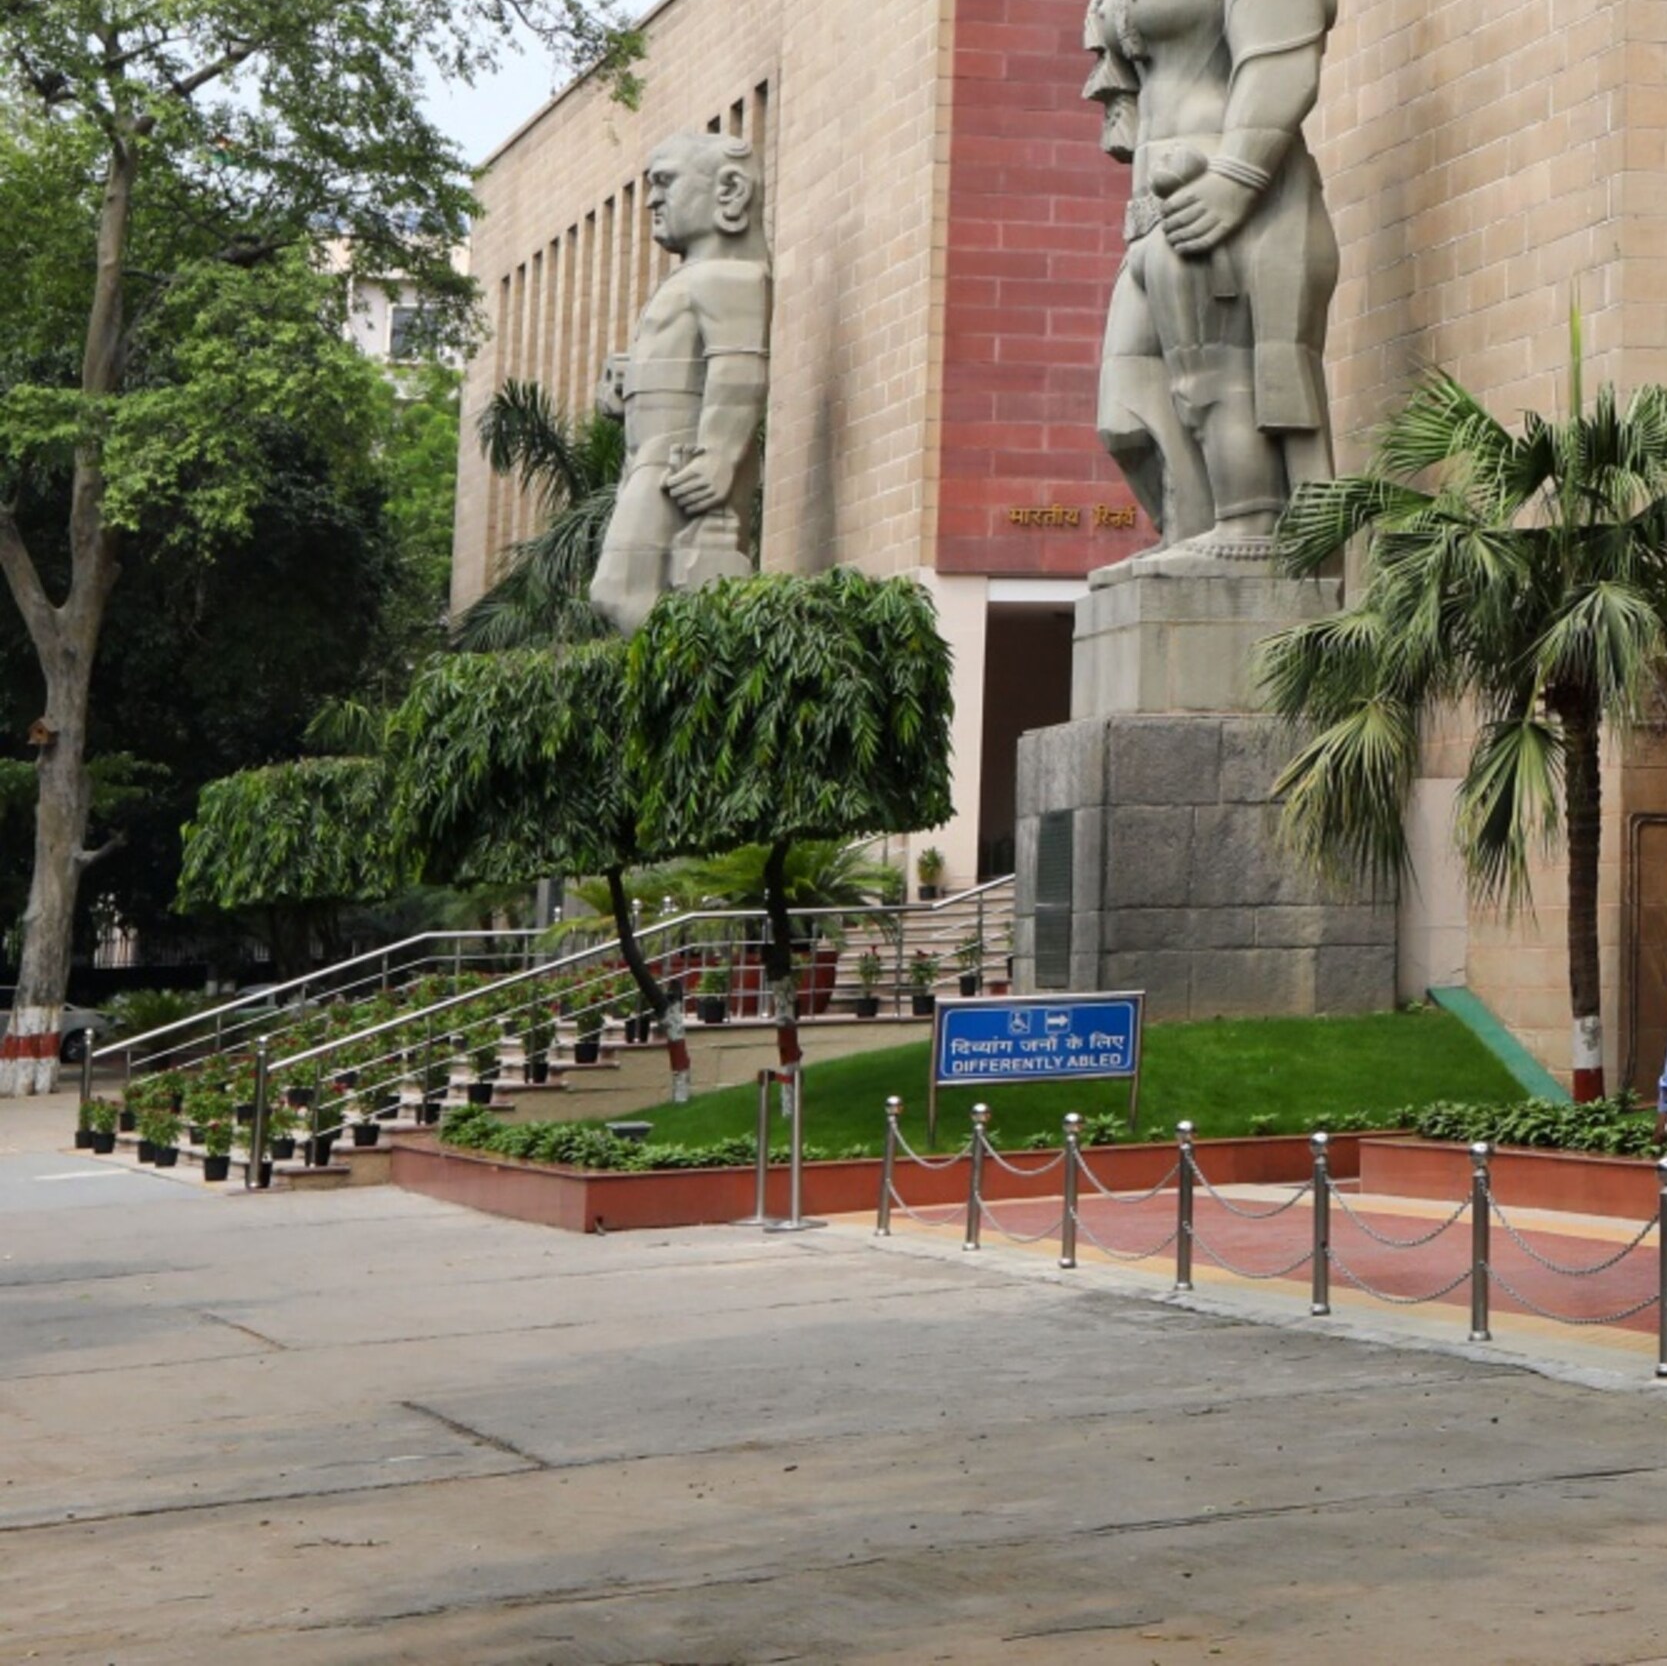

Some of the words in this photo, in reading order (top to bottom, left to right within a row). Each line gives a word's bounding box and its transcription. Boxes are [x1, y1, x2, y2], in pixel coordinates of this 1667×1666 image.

[1065, 1033, 1083, 1050] के
[1089, 1031, 1125, 1050] लिए
[952, 1056, 1063, 1073] DIFFERENTLY
[1067, 1052, 1121, 1068] ABLED
